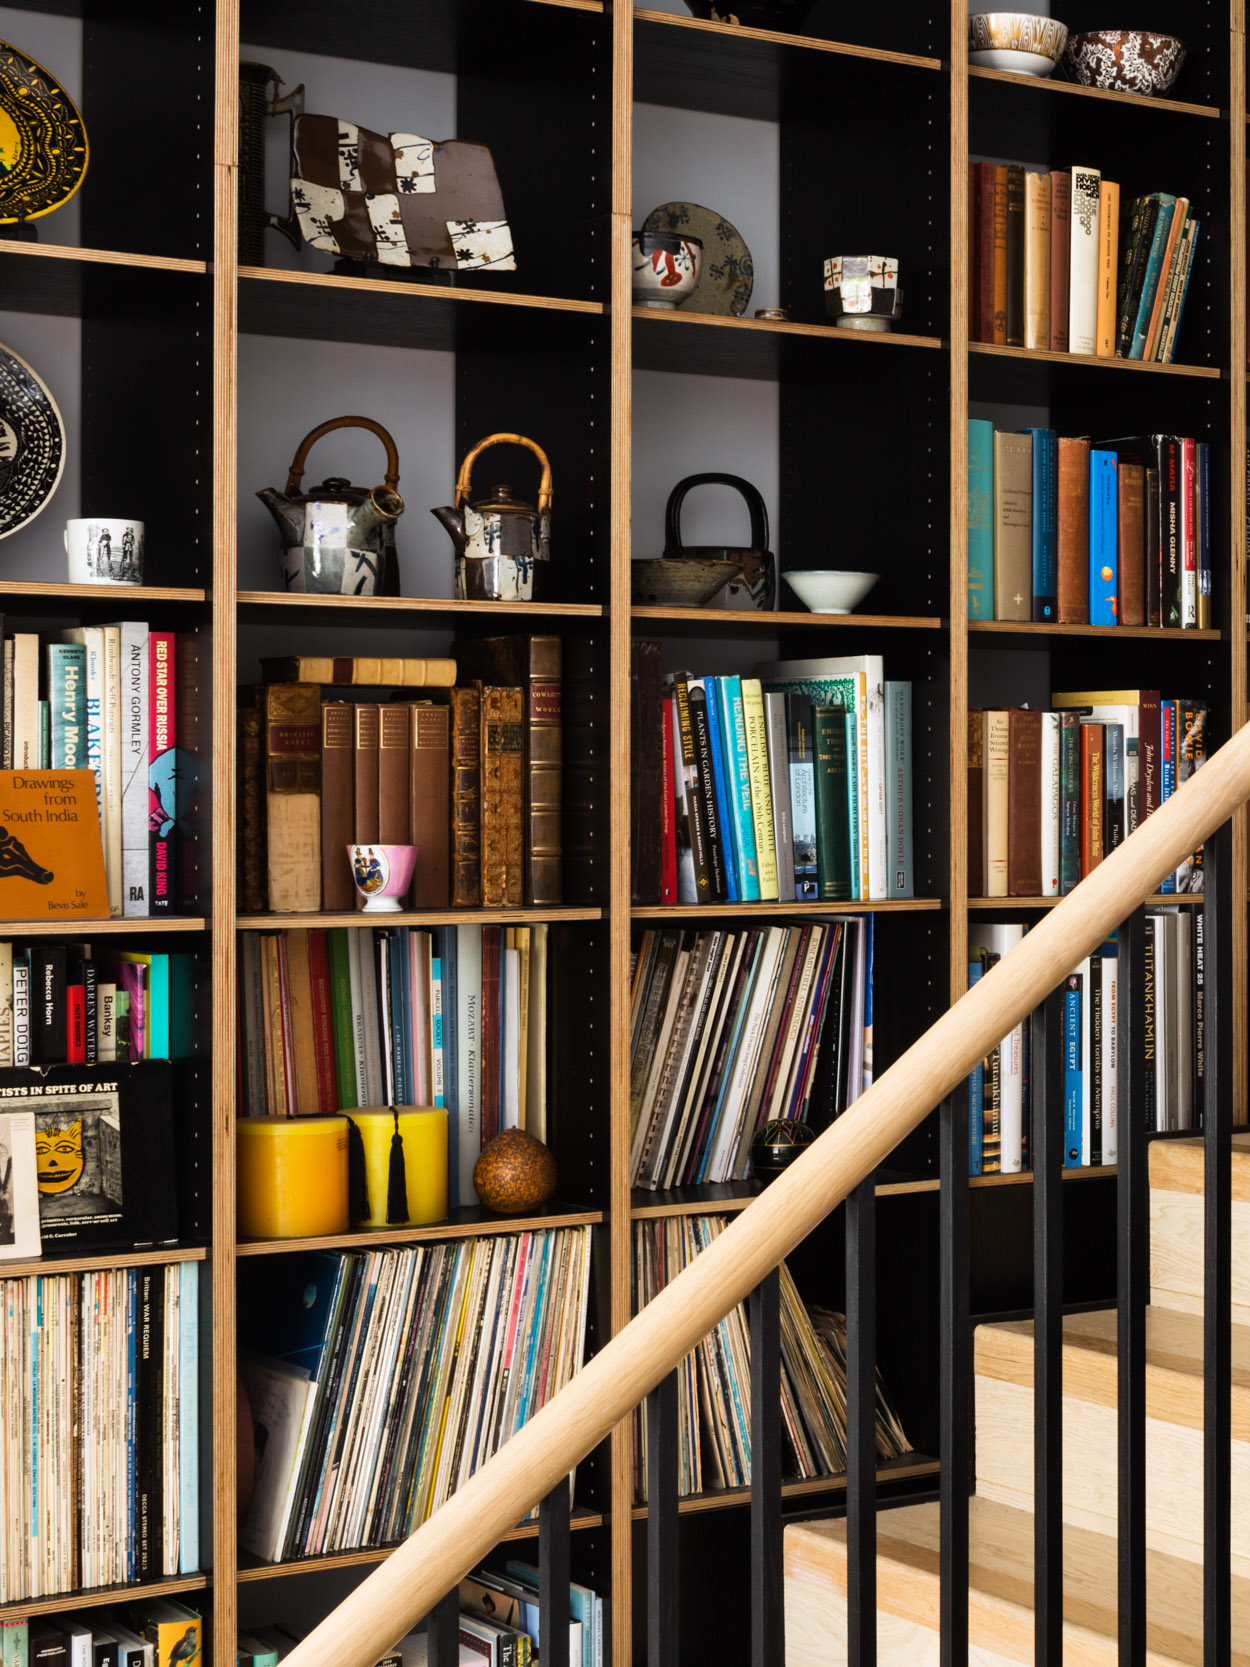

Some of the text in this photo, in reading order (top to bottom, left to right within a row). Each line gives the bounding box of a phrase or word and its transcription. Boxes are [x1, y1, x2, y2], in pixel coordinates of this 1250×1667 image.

[1080, 216, 1086, 228] OF
[89, 651, 98, 681] Klonsky
[62, 666, 79, 722] Henry
[130, 644, 142, 755] ANTONY GORMLEY
[156, 641, 167, 750] RED STAR OVER RUSSIA
[86, 698, 102, 779] BLAKE'S
[677, 684, 694, 758] RECLAIMING STYLE
[1185, 712, 1194, 760] BOWIE
[733, 697, 751, 811] RENDING THE VEIL
[748, 716, 760, 773] PORCELAIN
[13, 776, 74, 790] Drawings
[697, 712, 716, 838] PLANTS IN GARDEN HISTORY
[753, 776, 762, 784] of
[758, 715, 775, 854] ENGLISH BLUE AND WHITE
[1144, 743, 1154, 806] John Dryden and
[2, 808, 78, 823] South India
[44, 794, 77, 805] from
[755, 802, 763, 820] 18th
[742, 822, 750, 848] SHIVA
[756, 822, 765, 854] Century
[1110, 824, 1118, 846] Philip
[156, 842, 167, 895] DAVID KING
[48, 899, 88, 910] Bevis Sale
[75, 888, 86, 899] by
[130, 887, 144, 902] RA
[46, 964, 54, 1025] Rebecca Horn
[86, 969, 96, 1016] DARREN
[789, 938, 818, 1042] JONI MITCHELL ANTHOLOGY
[1197, 973, 1203, 985] 25
[16, 970, 28, 1063] PETER DOIG
[102, 996, 114, 1037] Banksy
[1144, 944, 1154, 1060] TUTANKHAMUN
[747, 1034, 756, 1051] Drake
[1110, 1026, 1116, 1035] TO
[468, 994, 476, 1134] MOZART Klaviersonaten
[738, 1064, 749, 1089] Collection
[743, 1052, 752, 1063] Song
[1093, 989, 1102, 1130] The Hidden Tombs of Memphis
[30, 1082, 118, 1095] IN SPITE OF ART
[992, 1054, 1001, 1139] Tutankhamun
[142, 1304, 150, 1322] WAR
[142, 1324, 150, 1360] REQUIEM
